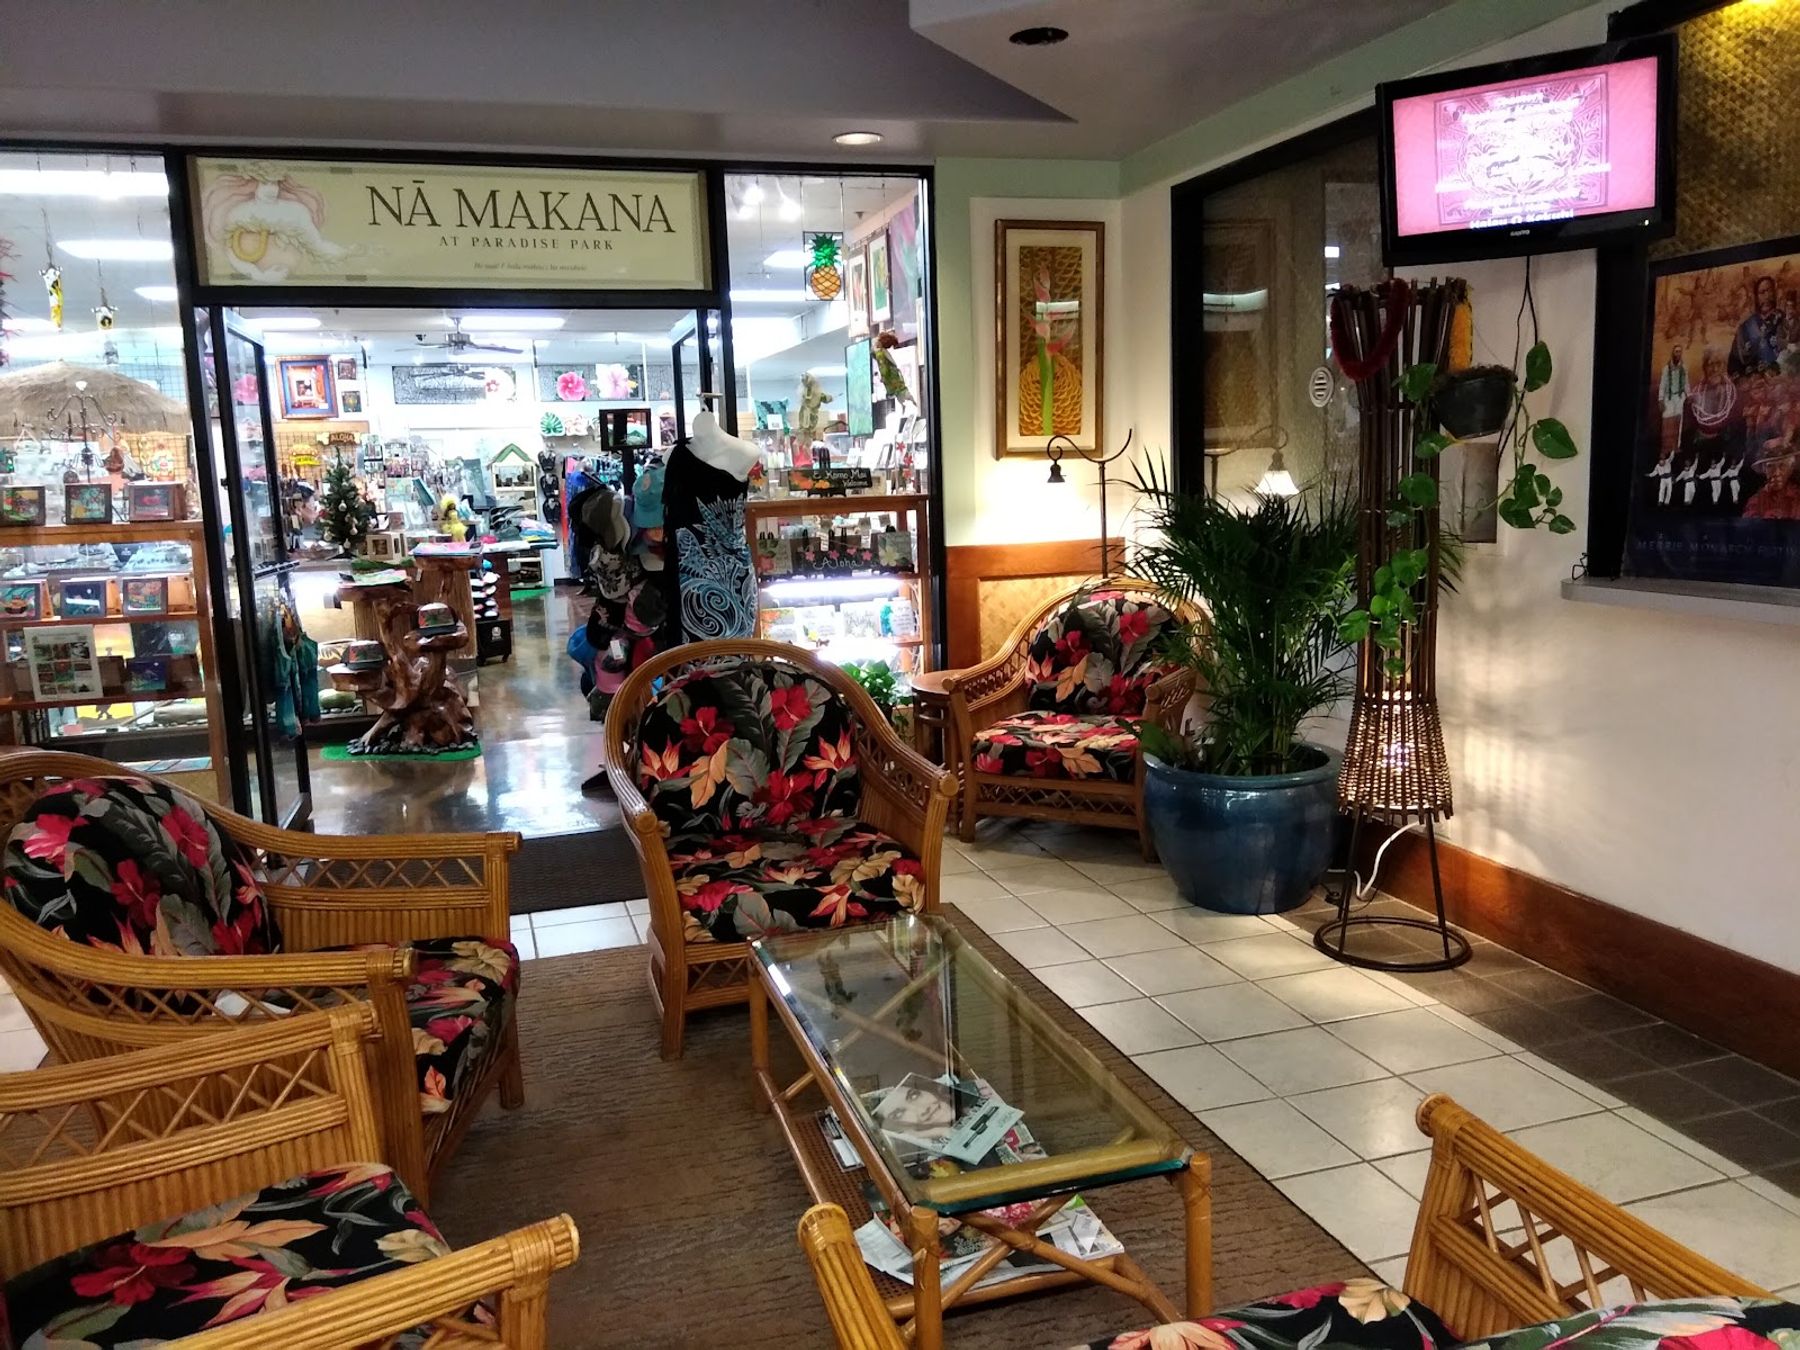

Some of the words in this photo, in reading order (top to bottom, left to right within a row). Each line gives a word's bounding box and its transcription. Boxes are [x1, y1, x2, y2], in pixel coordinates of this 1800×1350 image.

[366, 180, 441, 227] NĀ
[453, 188, 676, 233] MAKANA
[440, 236, 460, 247] AT
[472, 237, 559, 249] PARADISE
[571, 239, 613, 250] PARK
[813, 556, 863, 570] Aloha
